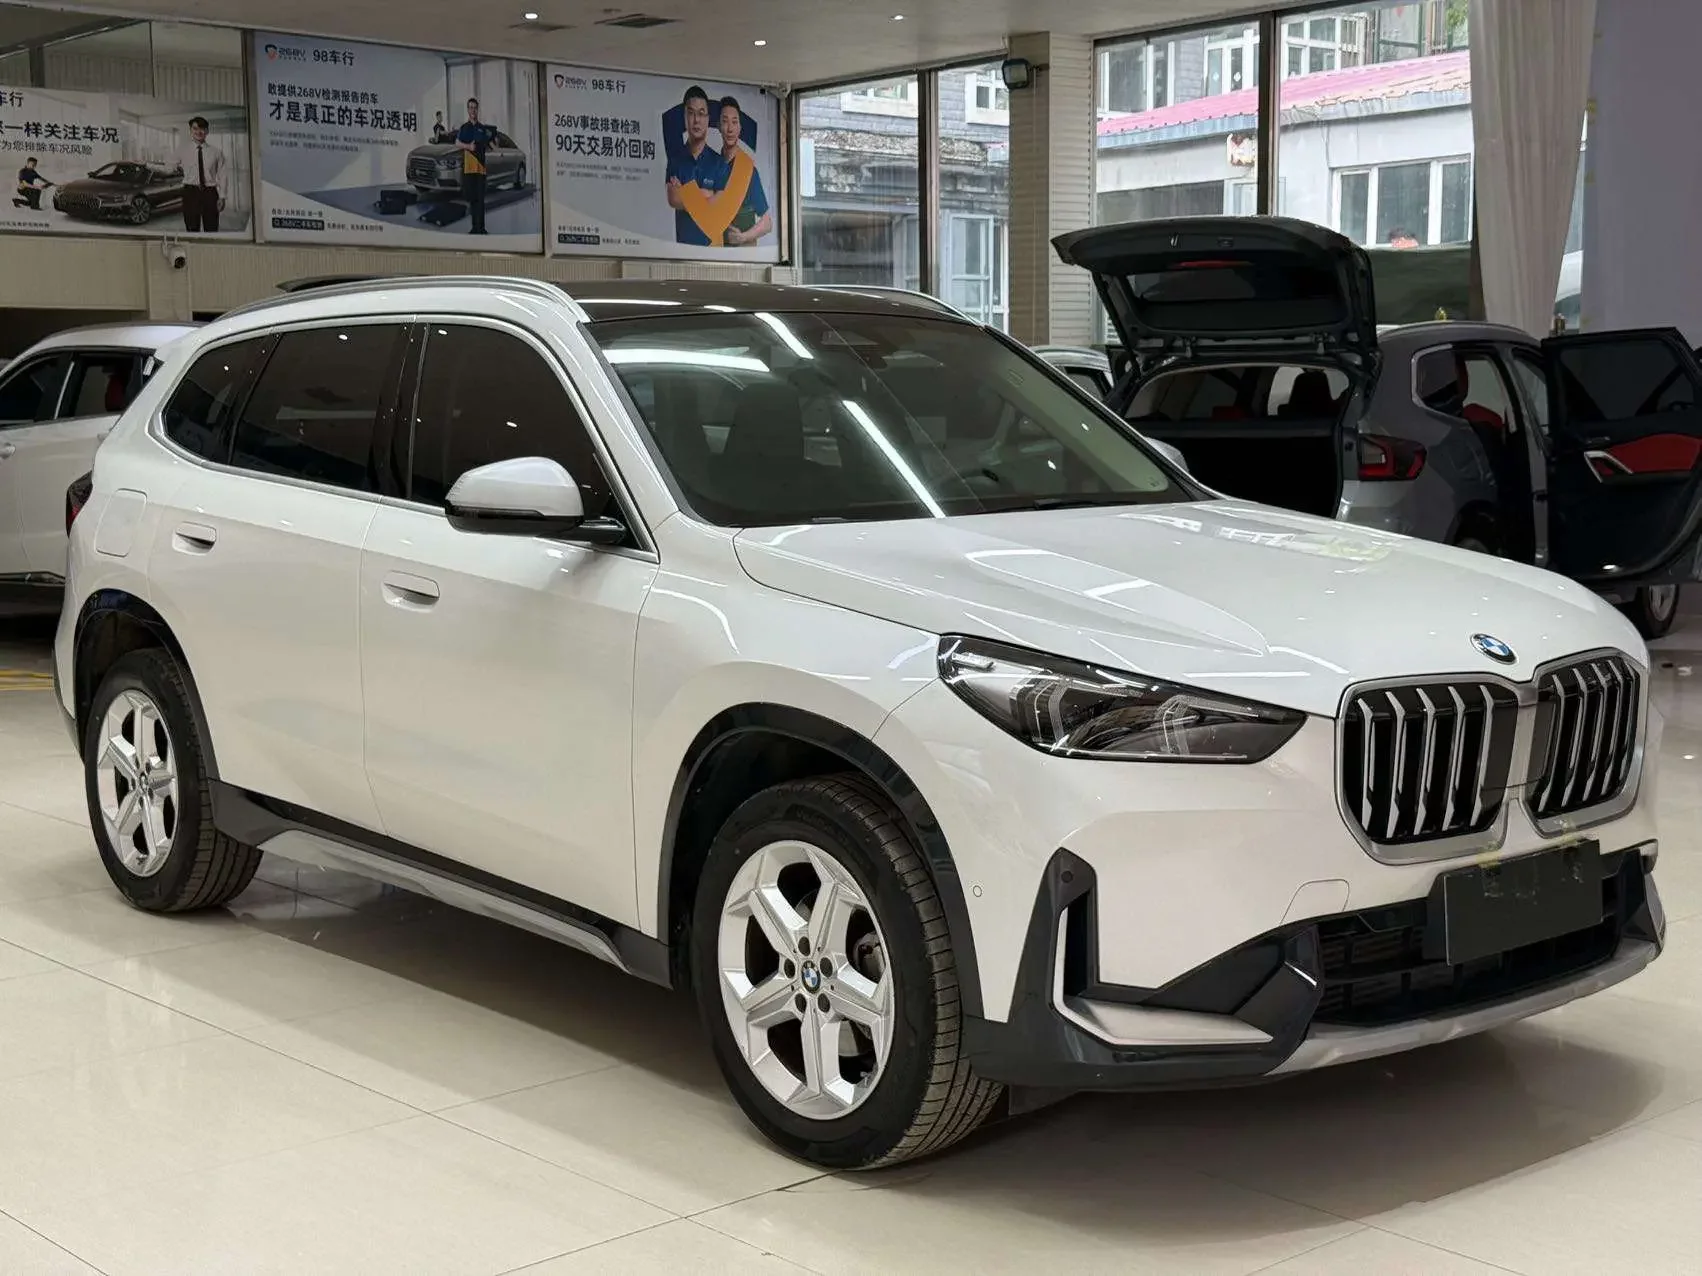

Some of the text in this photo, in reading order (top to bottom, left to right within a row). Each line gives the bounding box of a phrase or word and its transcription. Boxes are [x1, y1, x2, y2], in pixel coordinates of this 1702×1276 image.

[313, 49, 355, 66] 98车行
[592, 79, 627, 94] 98车行
[269, 99, 417, 132] 才是真正的车况透明
[554, 113, 641, 135] 268V事故排查检测
[0, 120, 120, 144] 一样关注车况
[555, 134, 656, 160] 90天交易价回购
